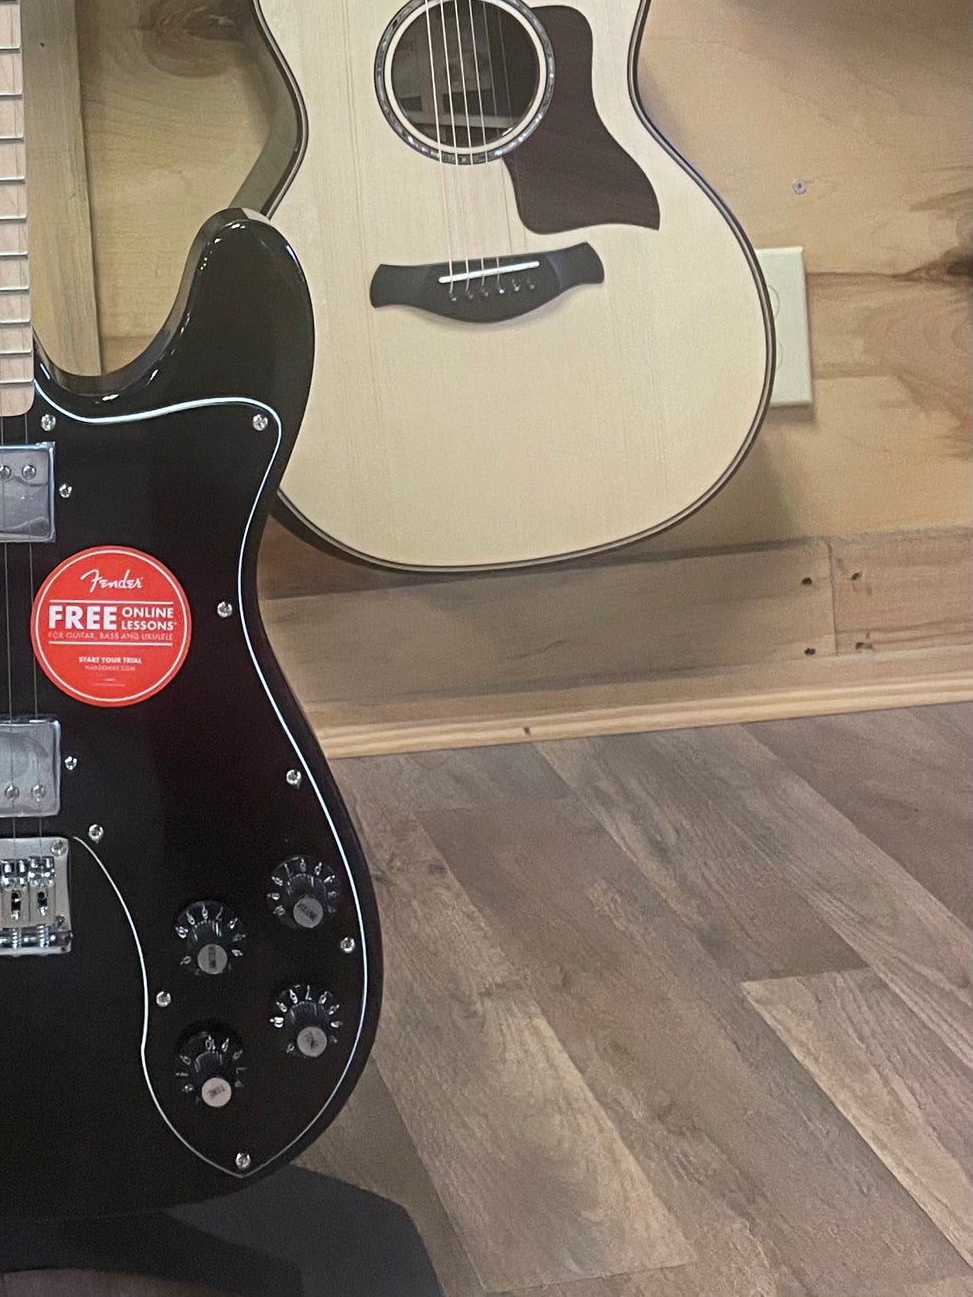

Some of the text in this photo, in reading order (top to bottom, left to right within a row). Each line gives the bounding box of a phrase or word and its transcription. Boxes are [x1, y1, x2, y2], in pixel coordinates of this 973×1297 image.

[80, 568, 143, 593] Fender
[48, 605, 118, 630] FREE
[121, 606, 174, 619] ONLINE
[99, 632, 119, 640] BASS
[120, 632, 139, 640] AND
[141, 633, 173, 641] UKULELE
[78, 656, 100, 664] START
